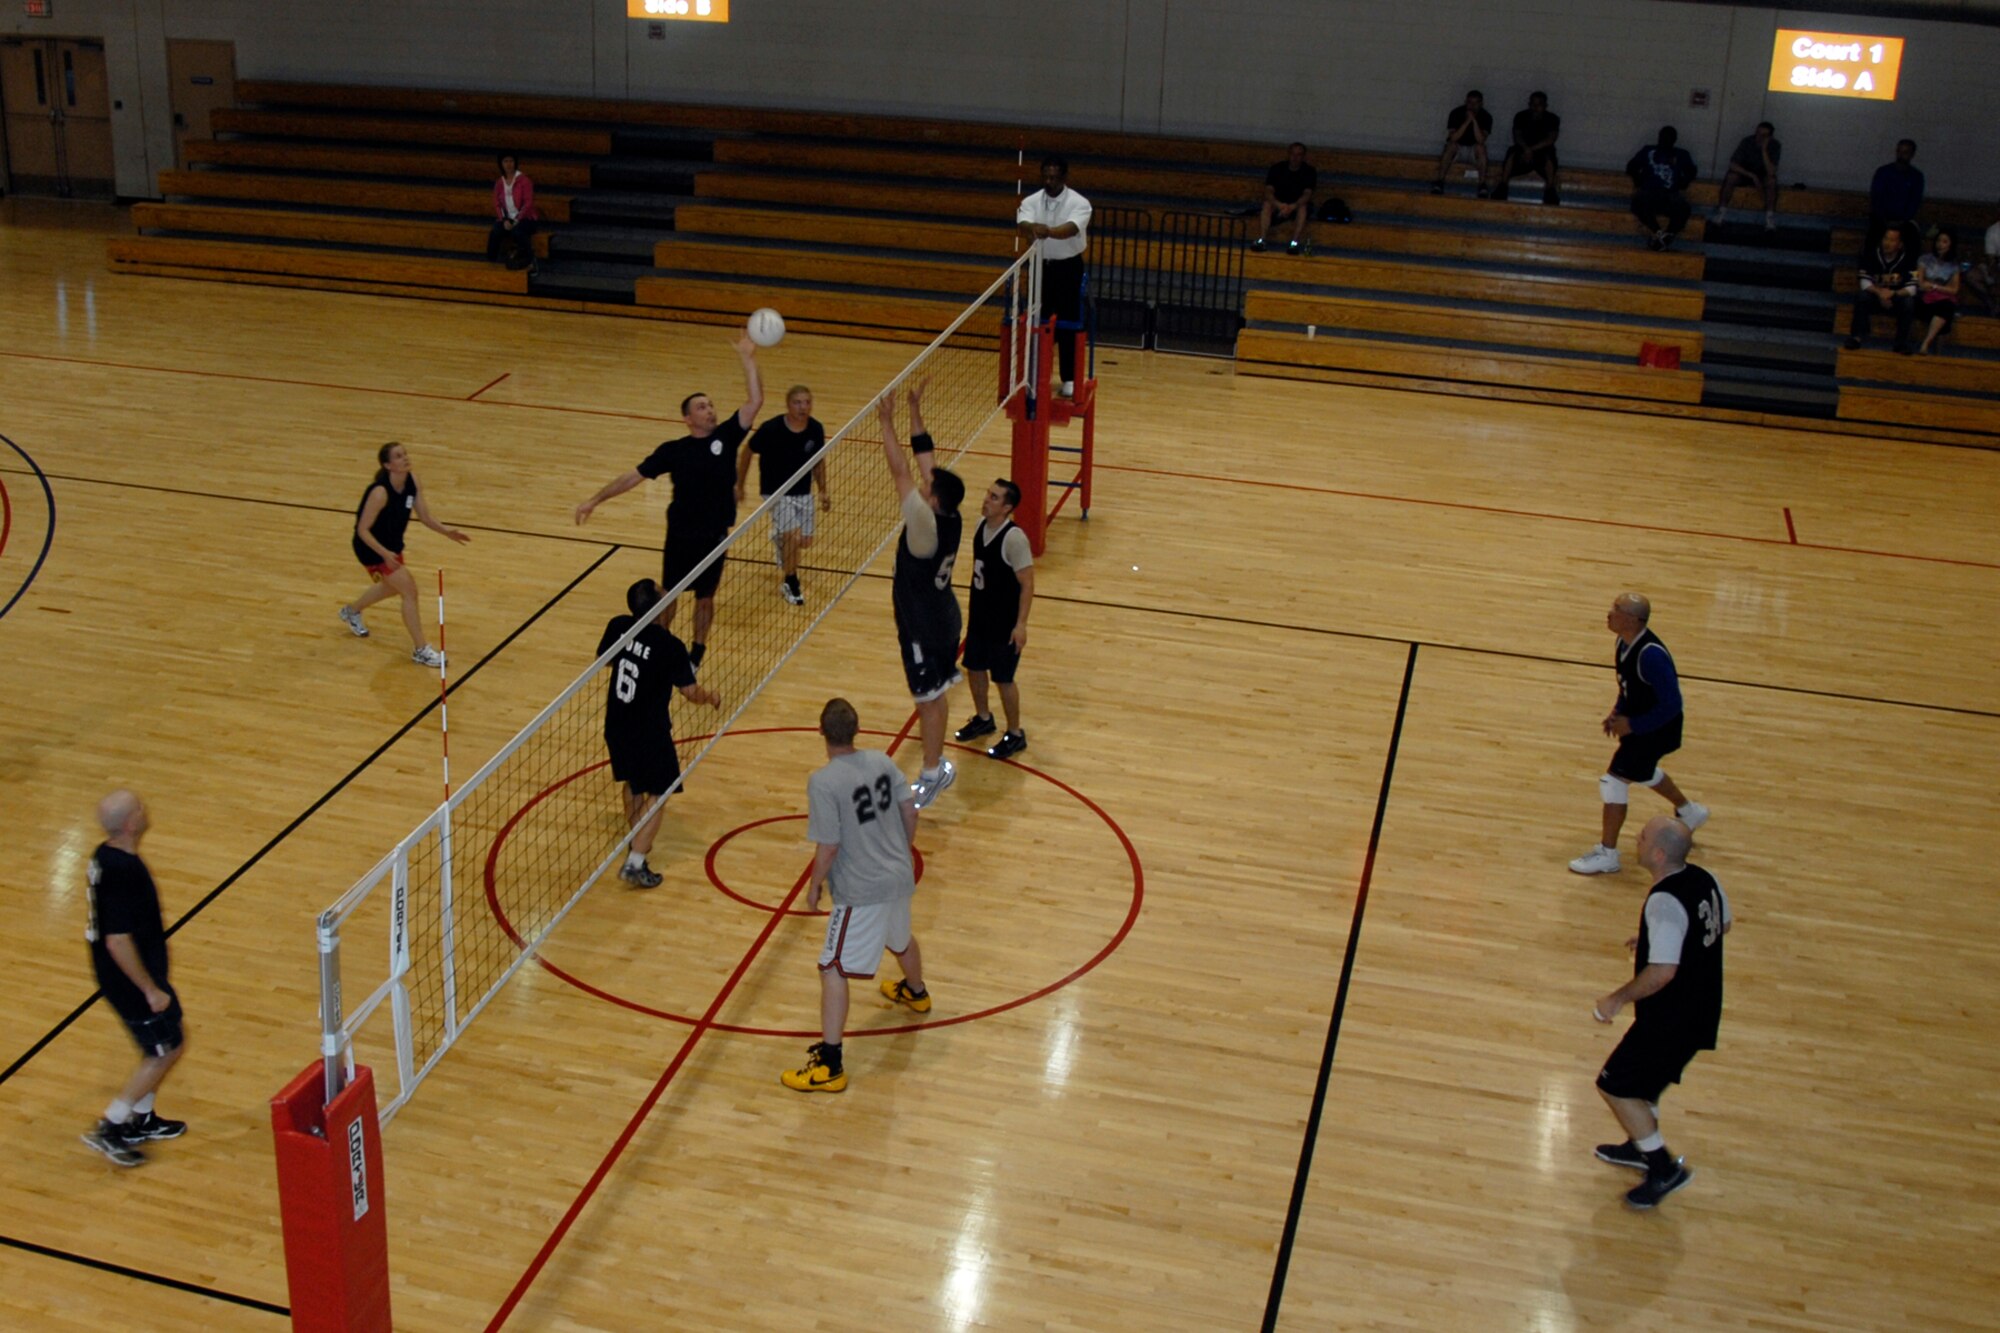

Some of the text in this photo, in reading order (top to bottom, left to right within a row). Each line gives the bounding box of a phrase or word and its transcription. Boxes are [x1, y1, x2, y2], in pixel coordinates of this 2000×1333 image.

[1791, 37, 1884, 64] Court 1
[1790, 65, 1873, 92] Side A
[615, 658, 640, 704] 6
[852, 774, 892, 825] 23
